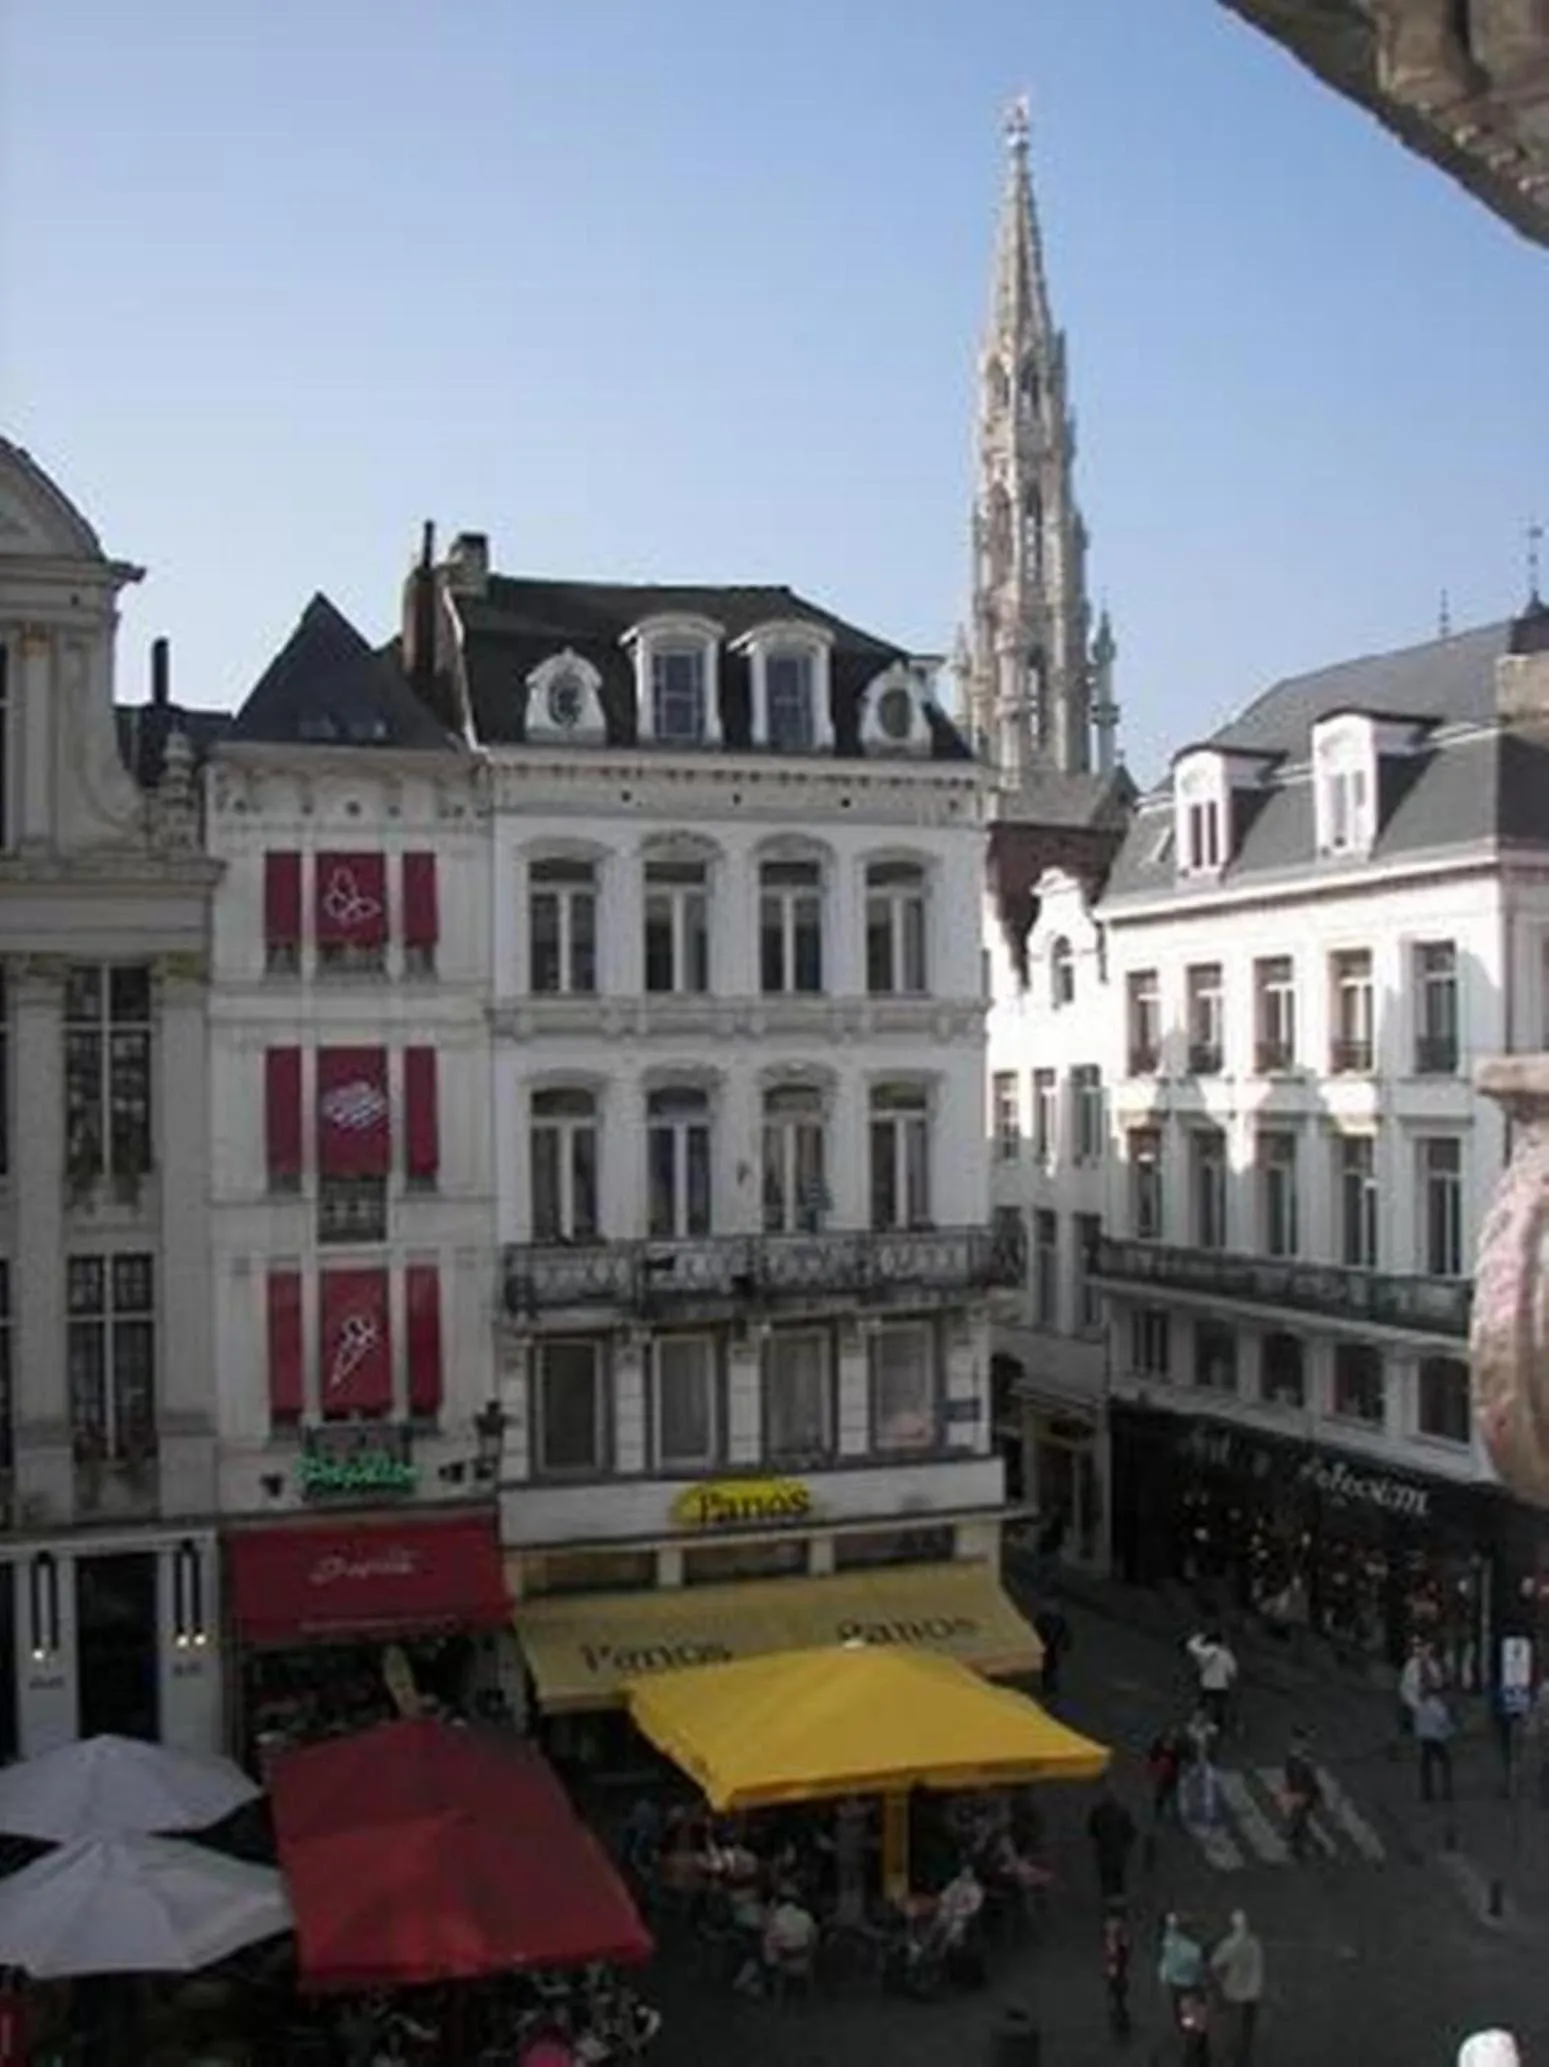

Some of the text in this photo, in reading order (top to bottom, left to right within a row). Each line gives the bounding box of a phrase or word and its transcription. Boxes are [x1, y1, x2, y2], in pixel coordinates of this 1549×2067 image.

[699, 1479, 812, 1524] Panos
[834, 1613, 981, 1649] Panos
[580, 1639, 733, 1678] Panos
